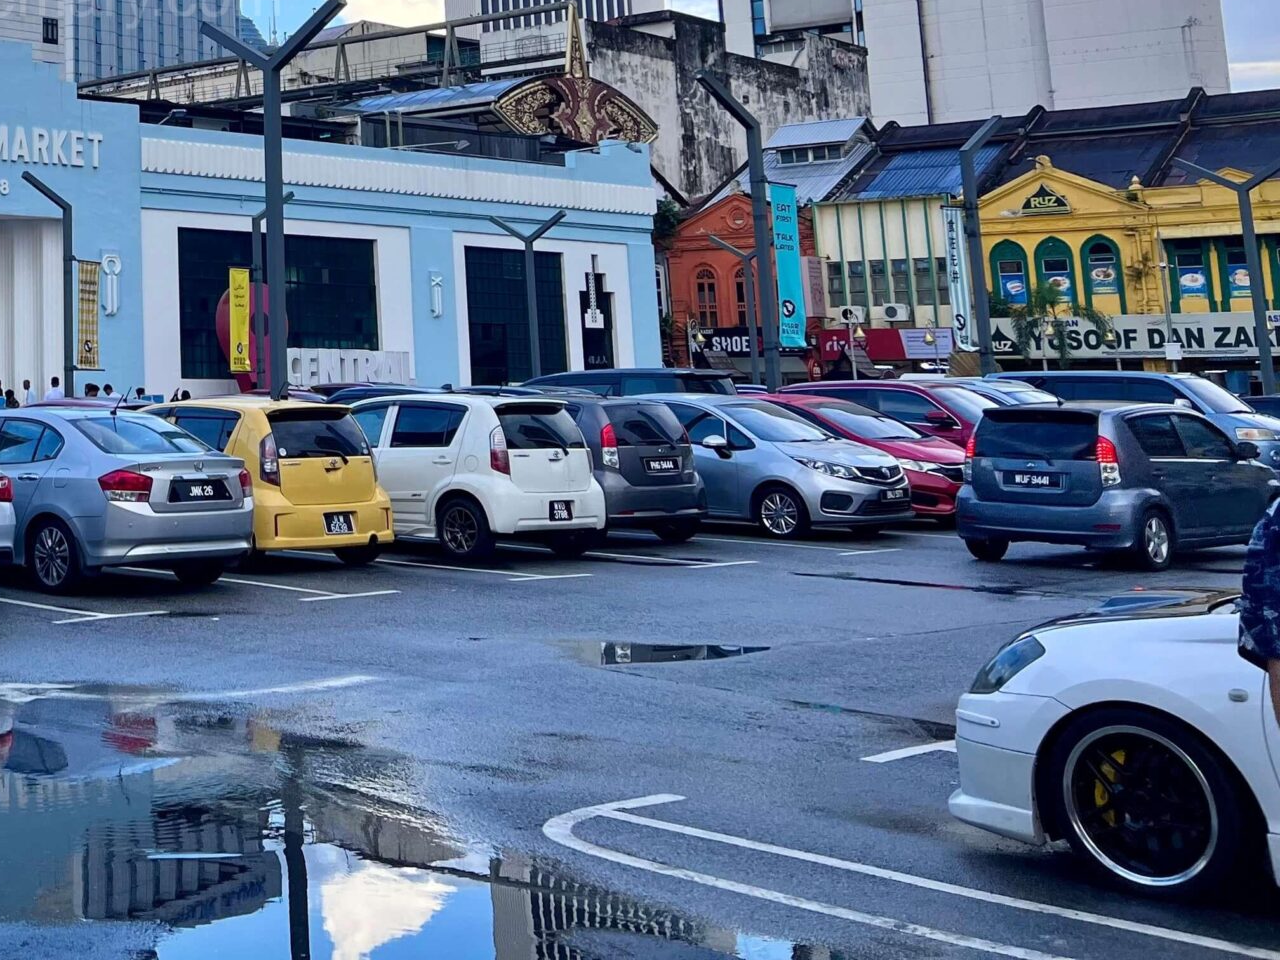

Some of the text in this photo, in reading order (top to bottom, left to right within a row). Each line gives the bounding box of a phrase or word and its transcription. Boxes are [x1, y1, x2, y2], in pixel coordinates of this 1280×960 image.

[1030, 197, 1058, 208] RUZ
[776, 203, 791, 213] EAT
[776, 214, 792, 223] FIRST
[775, 233, 794, 242] TALK
[775, 244, 795, 252] LATER
[203, 485, 214, 496] 26
